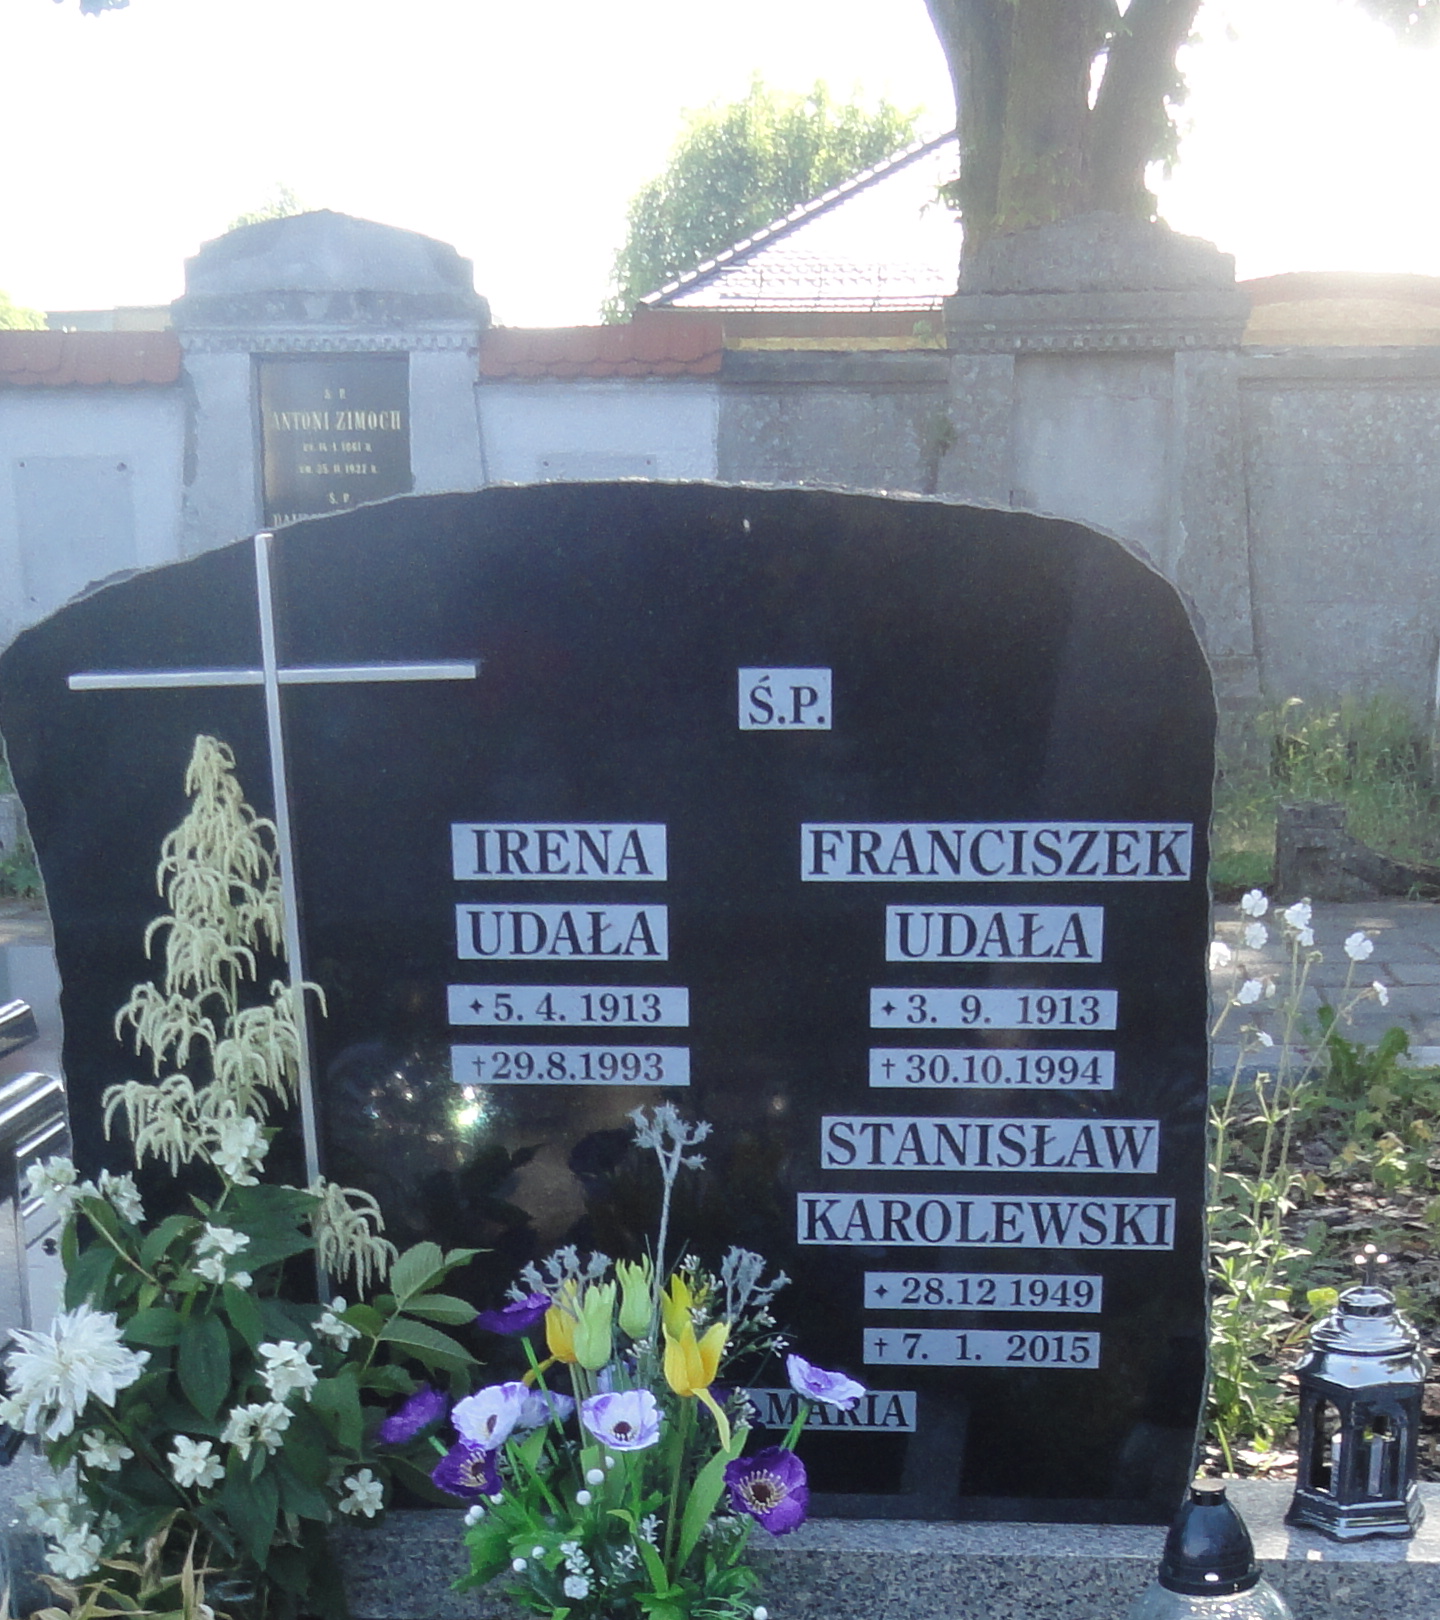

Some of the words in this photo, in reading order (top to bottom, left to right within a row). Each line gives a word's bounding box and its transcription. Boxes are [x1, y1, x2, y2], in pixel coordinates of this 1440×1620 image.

[272, 410, 330, 431] ANTONI
[336, 410, 402, 431] ZIMOCH
[748, 674, 825, 725] Ś.P.
[471, 828, 654, 876] IRENA
[807, 828, 1190, 877] FRANCISZEK
[466, 909, 662, 957] UDAŁA
[895, 911, 1093, 959] UDAŁA
[580, 992, 663, 1023] 1913
[1016, 994, 1101, 1026] 1913
[491, 1050, 665, 1082] 29.8.1993
[905, 1054, 1103, 1086] 30.10.1994
[825, 1121, 1157, 1170] STANISŁAW
[801, 1197, 1172, 1247] KAROLEWSKI
[1010, 1278, 1095, 1308] 1949
[1005, 1334, 1091, 1364] 2015
